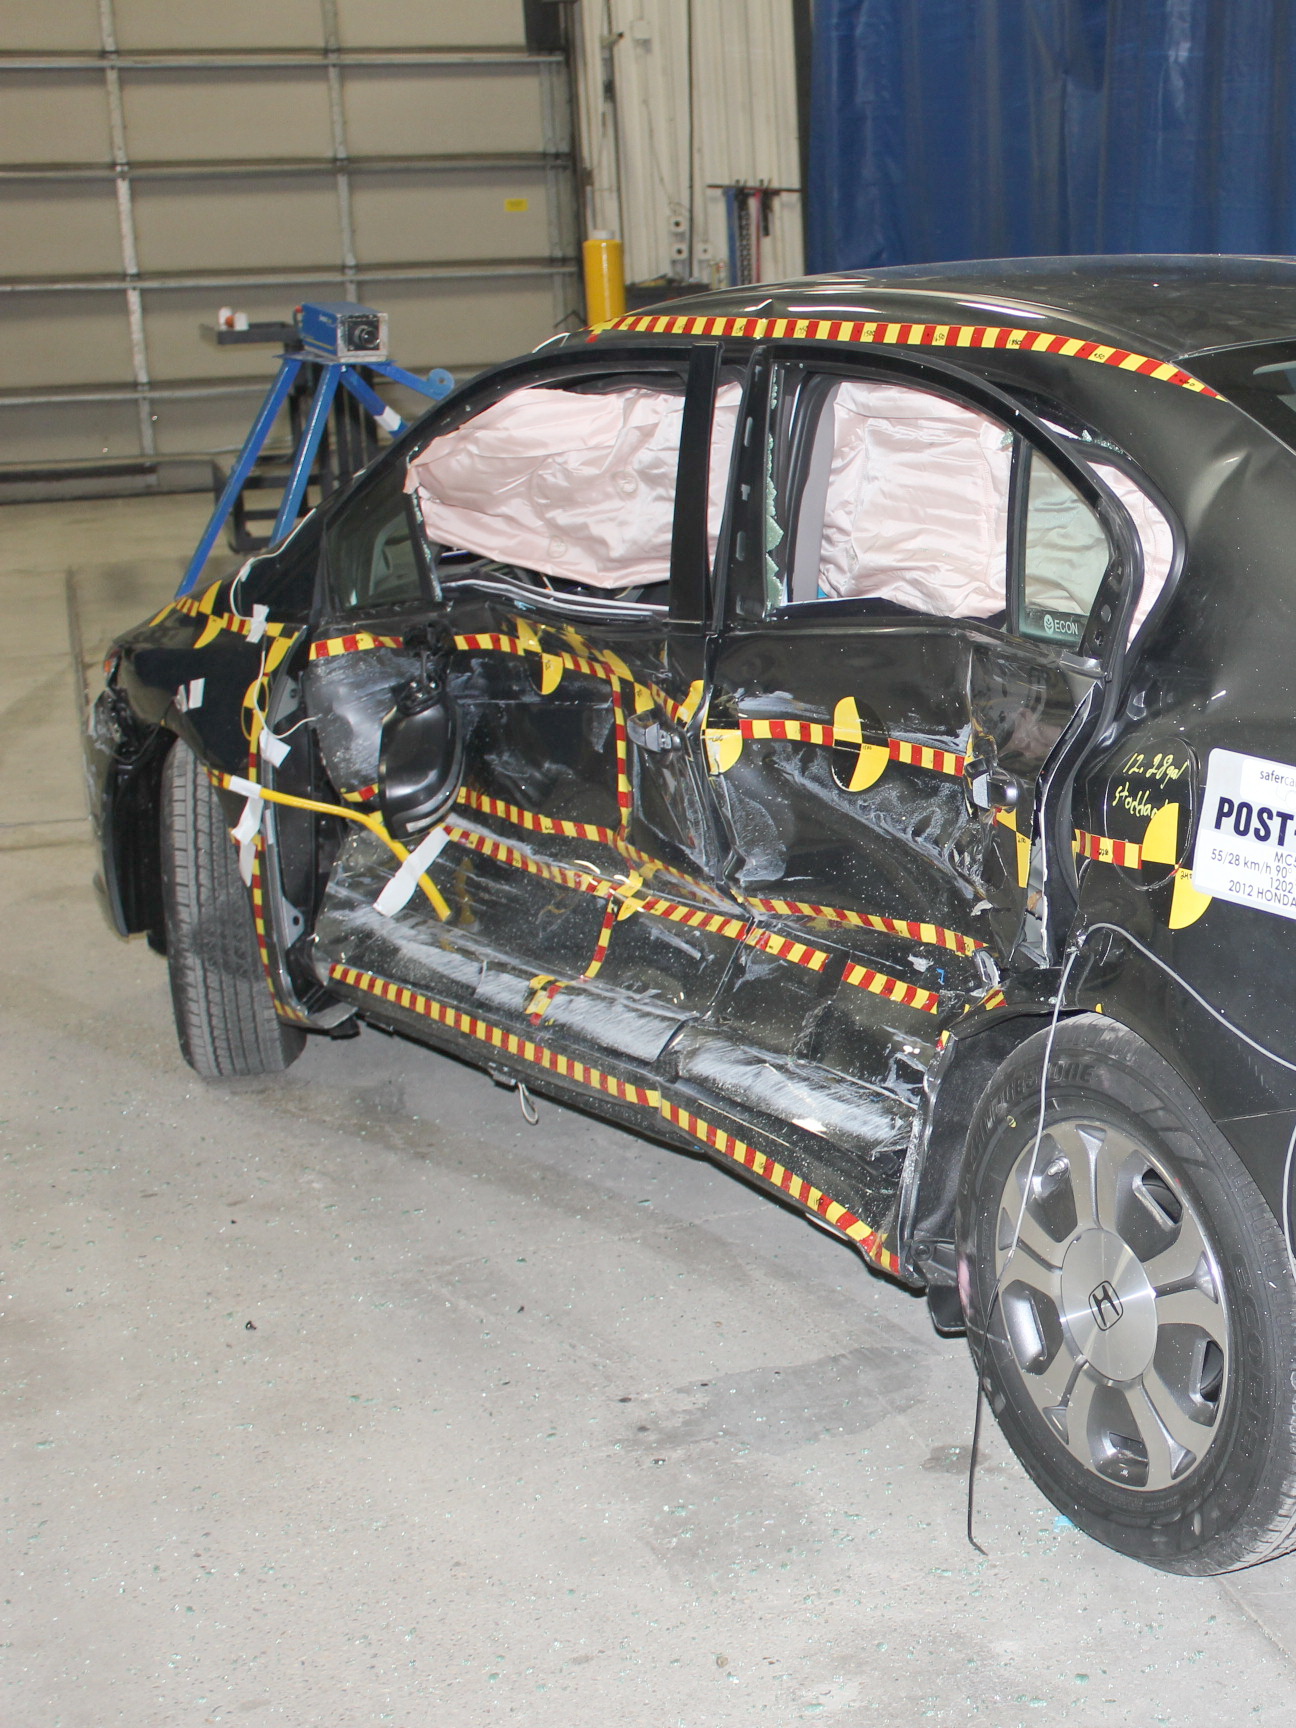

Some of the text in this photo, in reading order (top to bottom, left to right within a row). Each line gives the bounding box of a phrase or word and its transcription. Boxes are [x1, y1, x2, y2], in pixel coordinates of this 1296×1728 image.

[1054, 619, 1079, 635] ECON
[1210, 848, 1241, 867] 55/28
[1243, 856, 1272, 875] km/h
[1275, 865, 1293, 879] 90°
[1228, 880, 1253, 897] 2012
